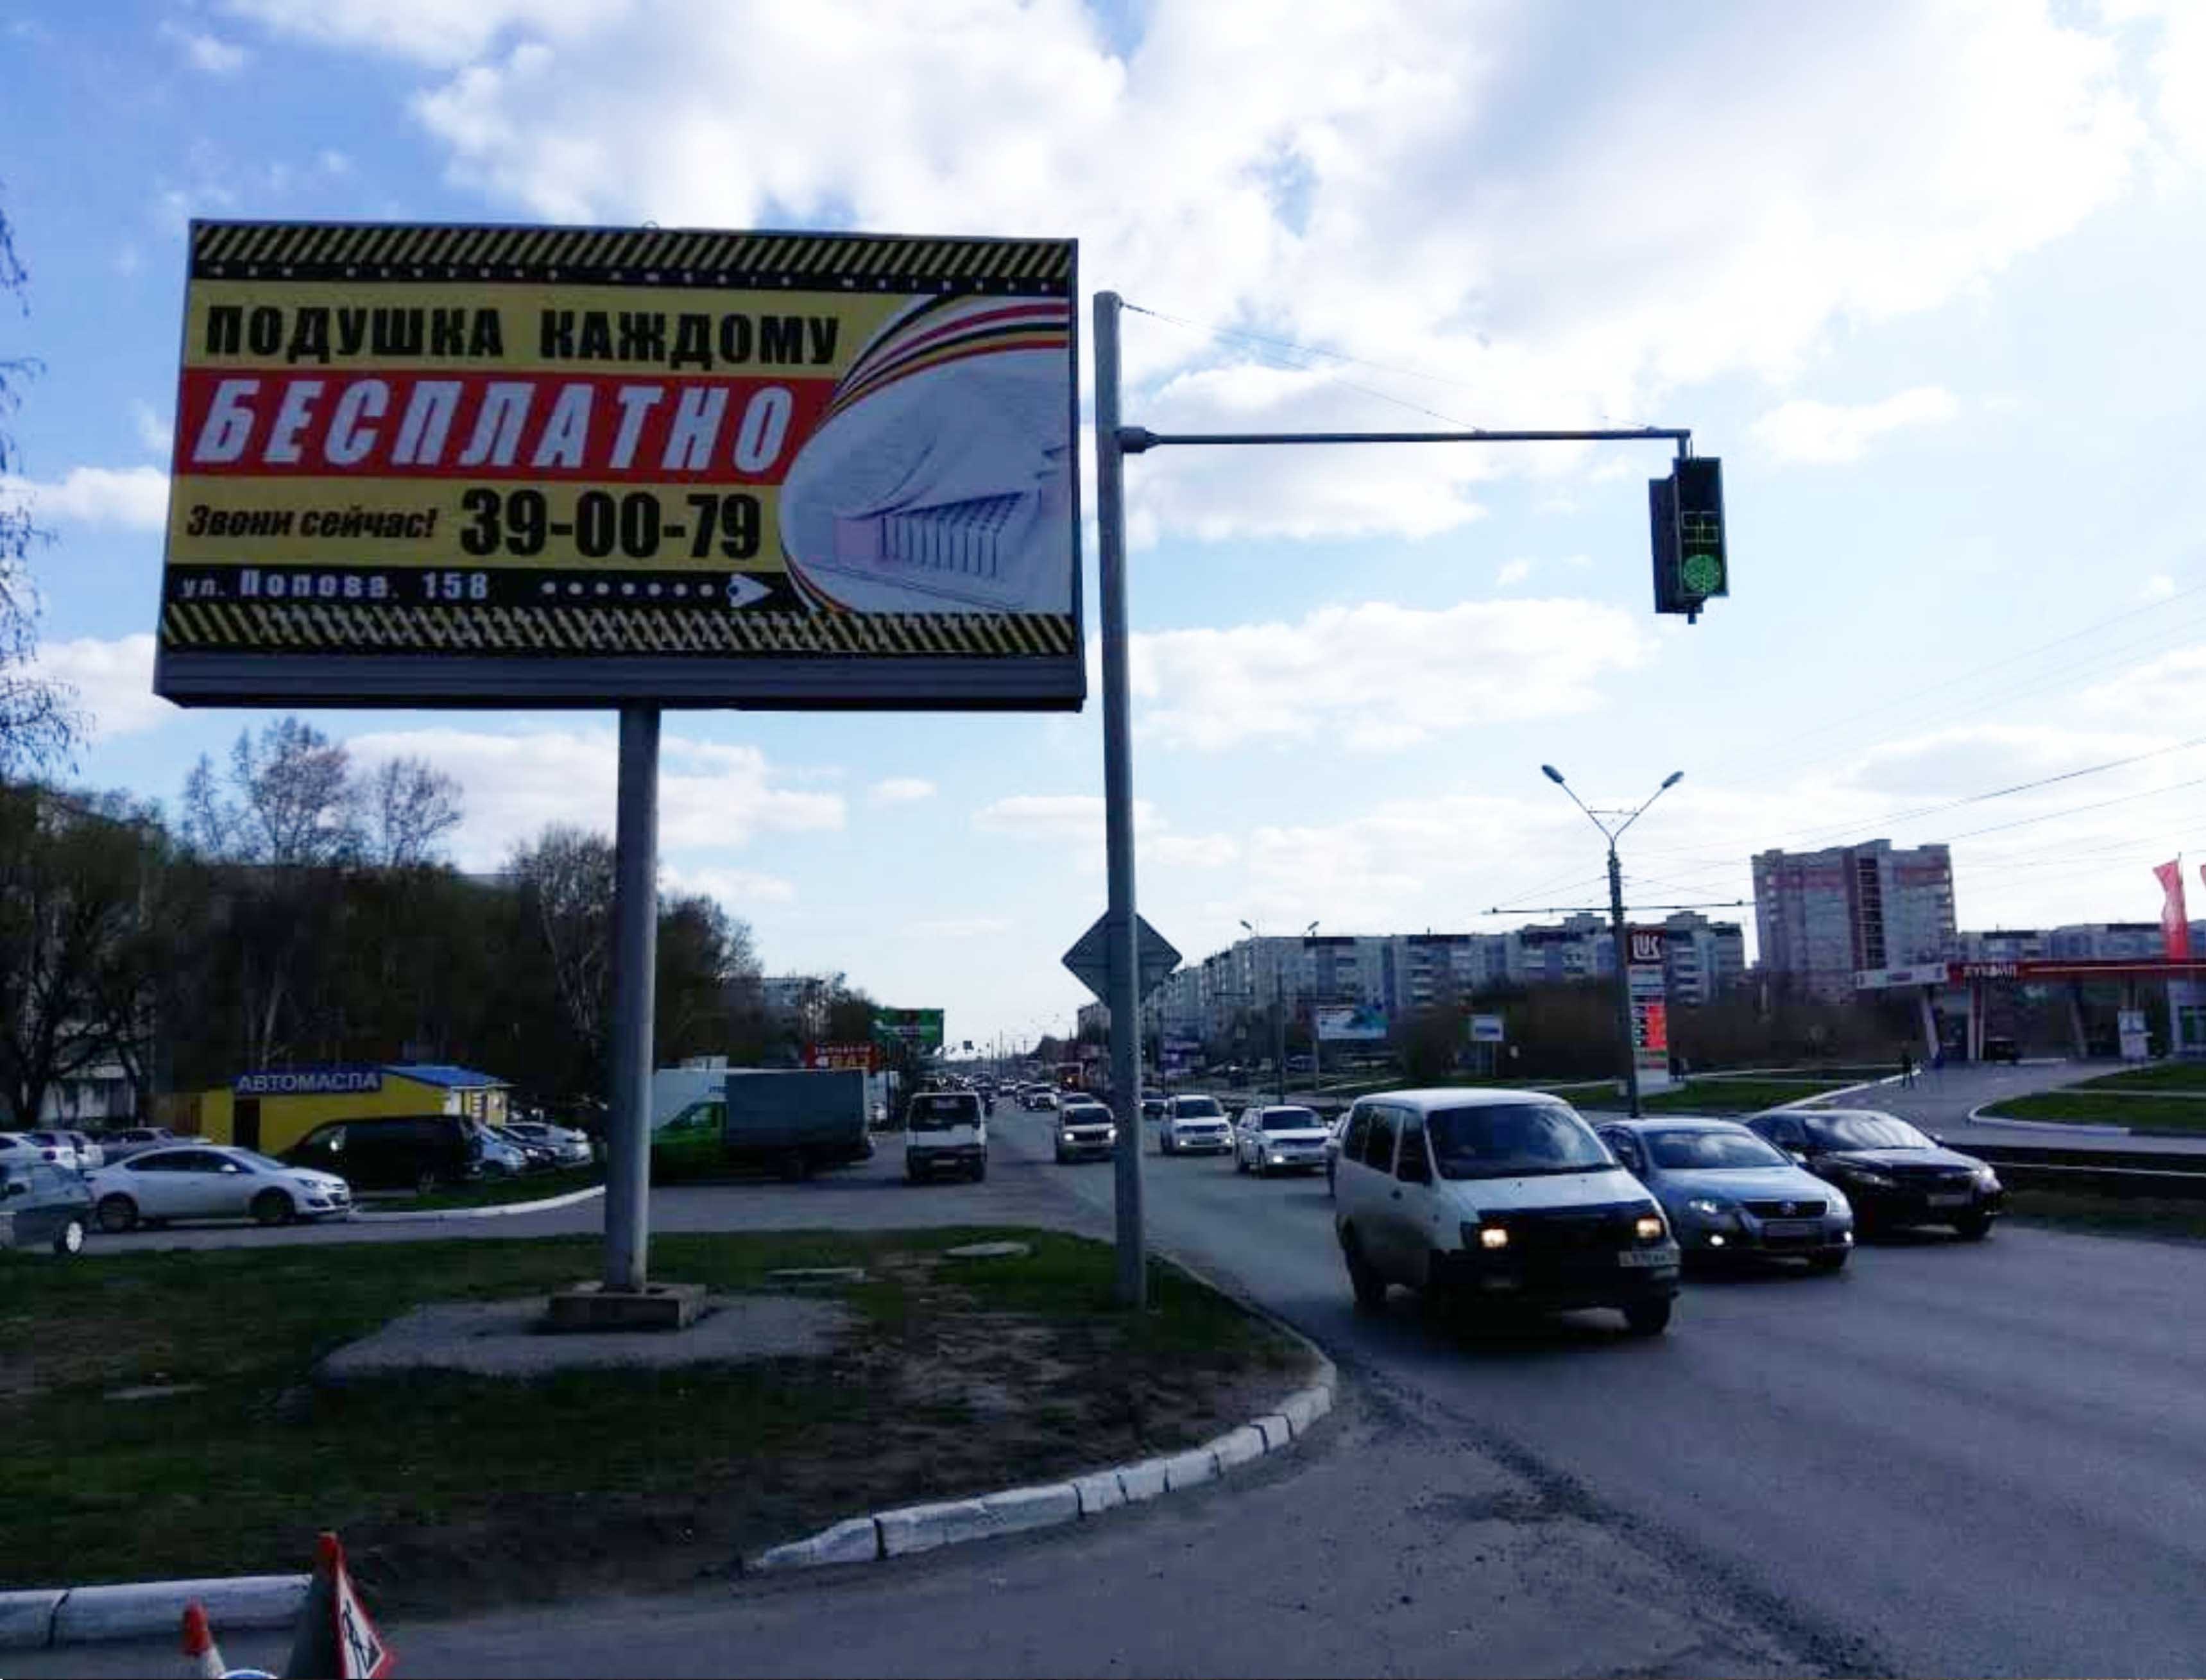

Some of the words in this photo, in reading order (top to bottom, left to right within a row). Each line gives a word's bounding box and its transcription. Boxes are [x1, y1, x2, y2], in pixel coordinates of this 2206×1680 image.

[206, 305, 504, 363] ПОДУШКА
[540, 309, 839, 370] КАЖДОМУ
[193, 379, 793, 473] БЕСПЛАТНО
[187, 505, 294, 537] Звони
[300, 505, 438, 538] сейчас!
[460, 488, 762, 560] 39-00-79
[182, 579, 225, 597] ул.
[422, 572, 488, 599] 158
